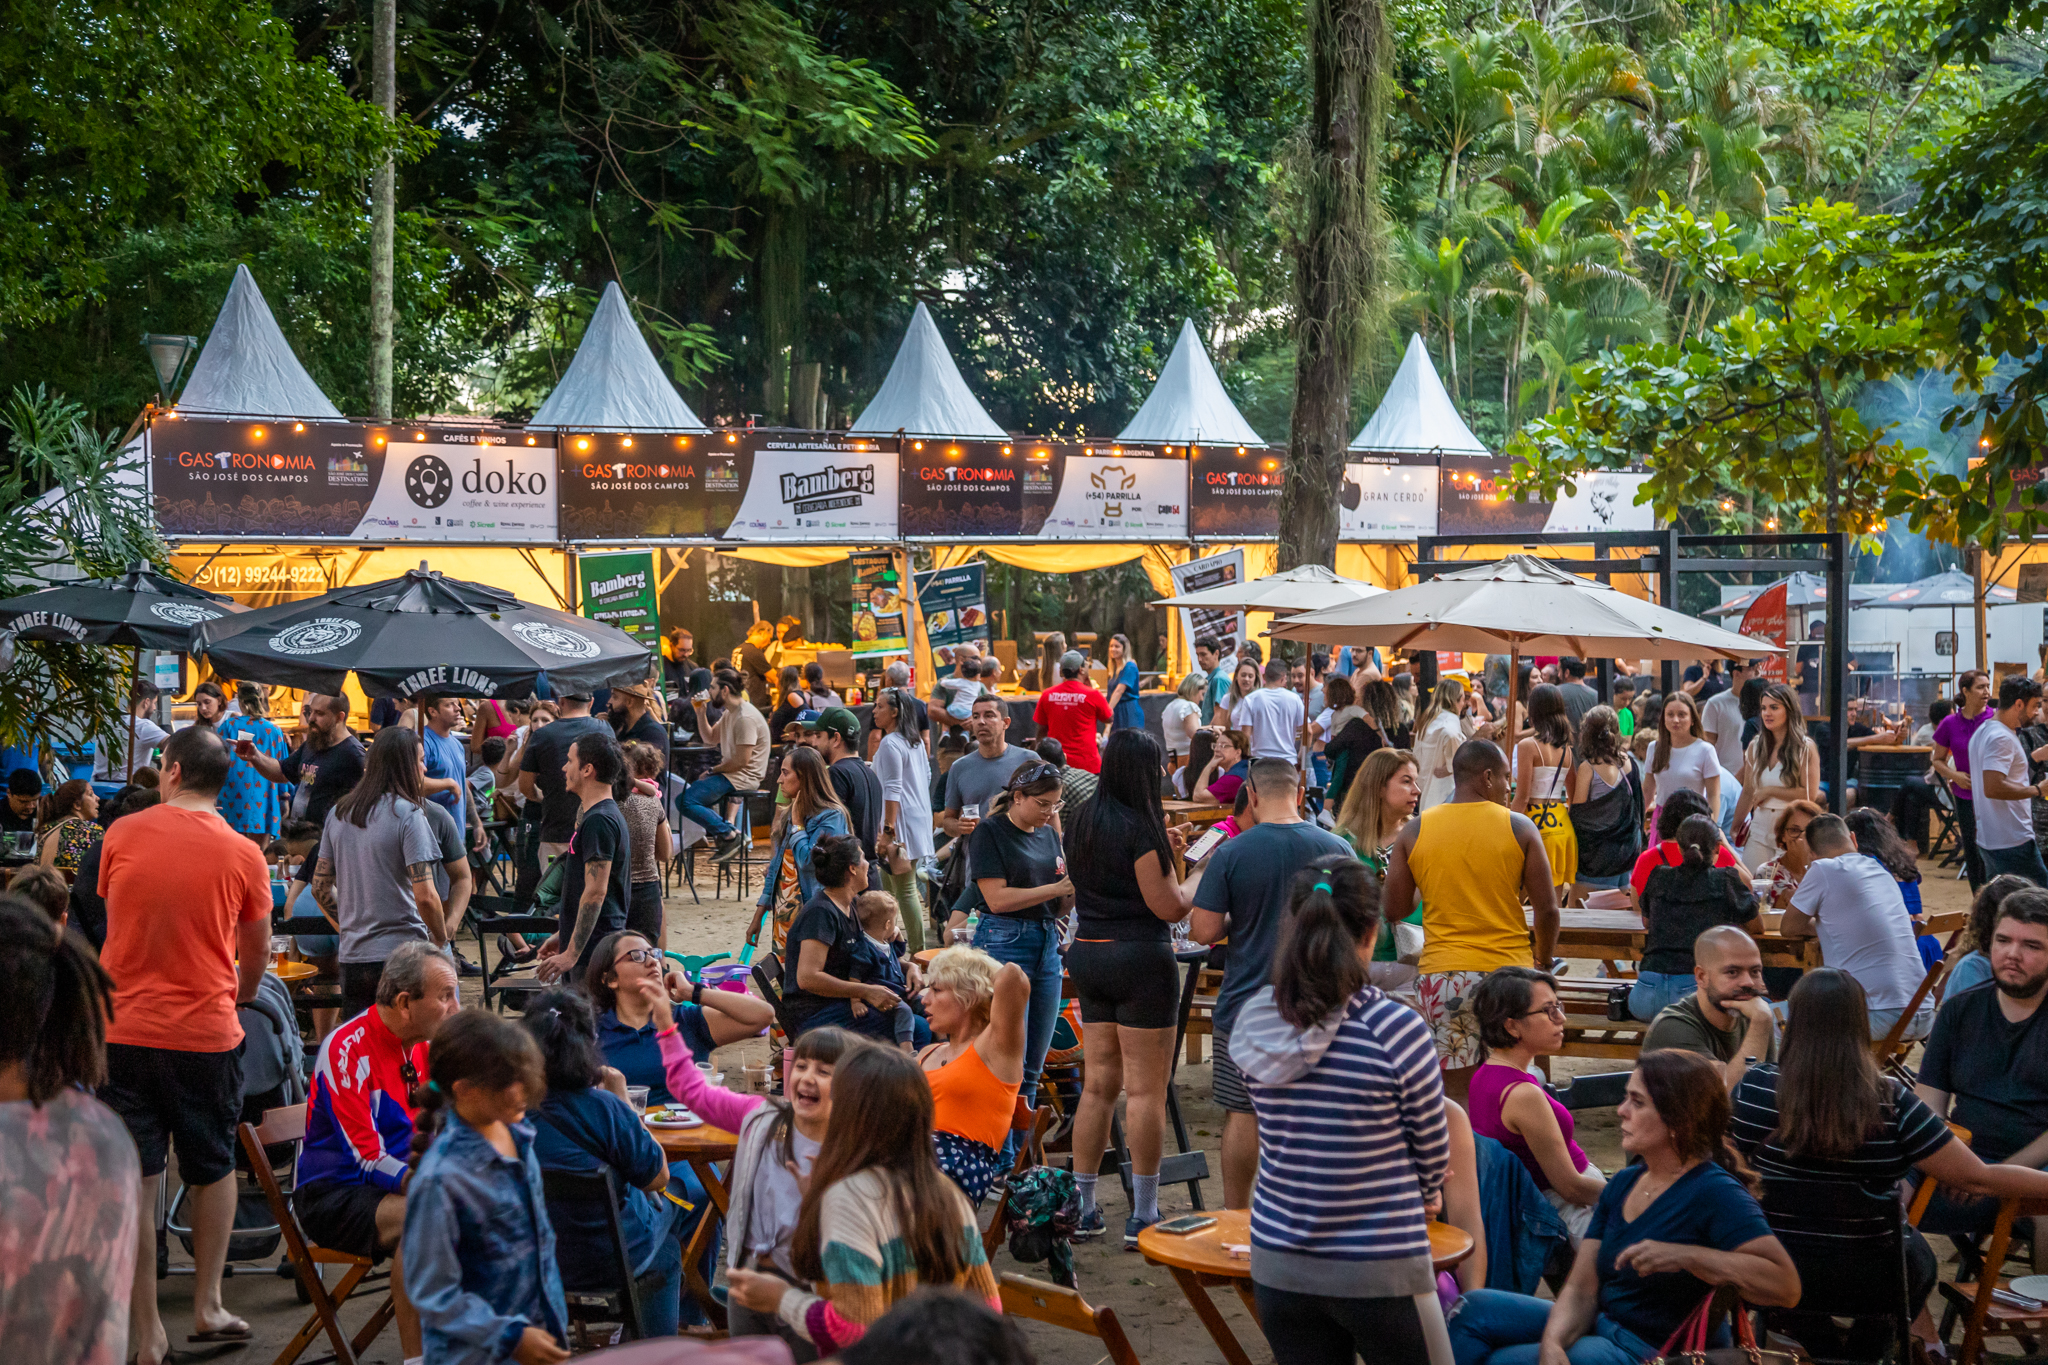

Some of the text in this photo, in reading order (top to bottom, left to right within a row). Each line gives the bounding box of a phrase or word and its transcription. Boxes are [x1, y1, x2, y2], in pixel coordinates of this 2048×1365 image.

[443, 433, 507, 444] CAFÉS E VINHOS
[766, 441, 797, 450] CERVEJA
[797, 442, 837, 450] ARTESANAL
[1123, 449, 1155, 457] ARGENTINA
[178, 451, 316, 470] GASTRONOMIA
[1362, 456, 1389, 464] AMERICAN
[189, 471, 309, 483] SÃO JOSÉ DOS CAMPOS
[462, 458, 547, 496] doko
[582, 463, 696, 480] GASTRONOMIA
[920, 466, 1016, 482] GASTRONOMIA
[327, 475, 369, 483] DESTINATION
[782, 467, 874, 502] Bamberg
[590, 480, 690, 490] SÃO JOSÉ DOS CAMPOS
[926, 484, 942, 492] SÃO
[943, 484, 962, 492] JOSÉ
[1085, 491, 1141, 501] (+54) PARRILLA
[1211, 487, 1225, 495] SÃO
[1226, 487, 1241, 495] JOSÉ
[1242, 488, 1256, 496] DOS
[1363, 492, 1424, 503] GRAN CERDO
[462, 499, 482, 508] coffee
[493, 500, 509, 508] wine
[510, 501, 546, 510] experience
[214, 565, 324, 588] (12) 99244-9222
[944, 574, 972, 585] PARRILLA
[589, 570, 647, 598] Bamberg
[8, 610, 89, 641] THREE LIONS
[397, 665, 499, 698] THREE LIONS
[337, 1025, 366, 1090] ULTRA
